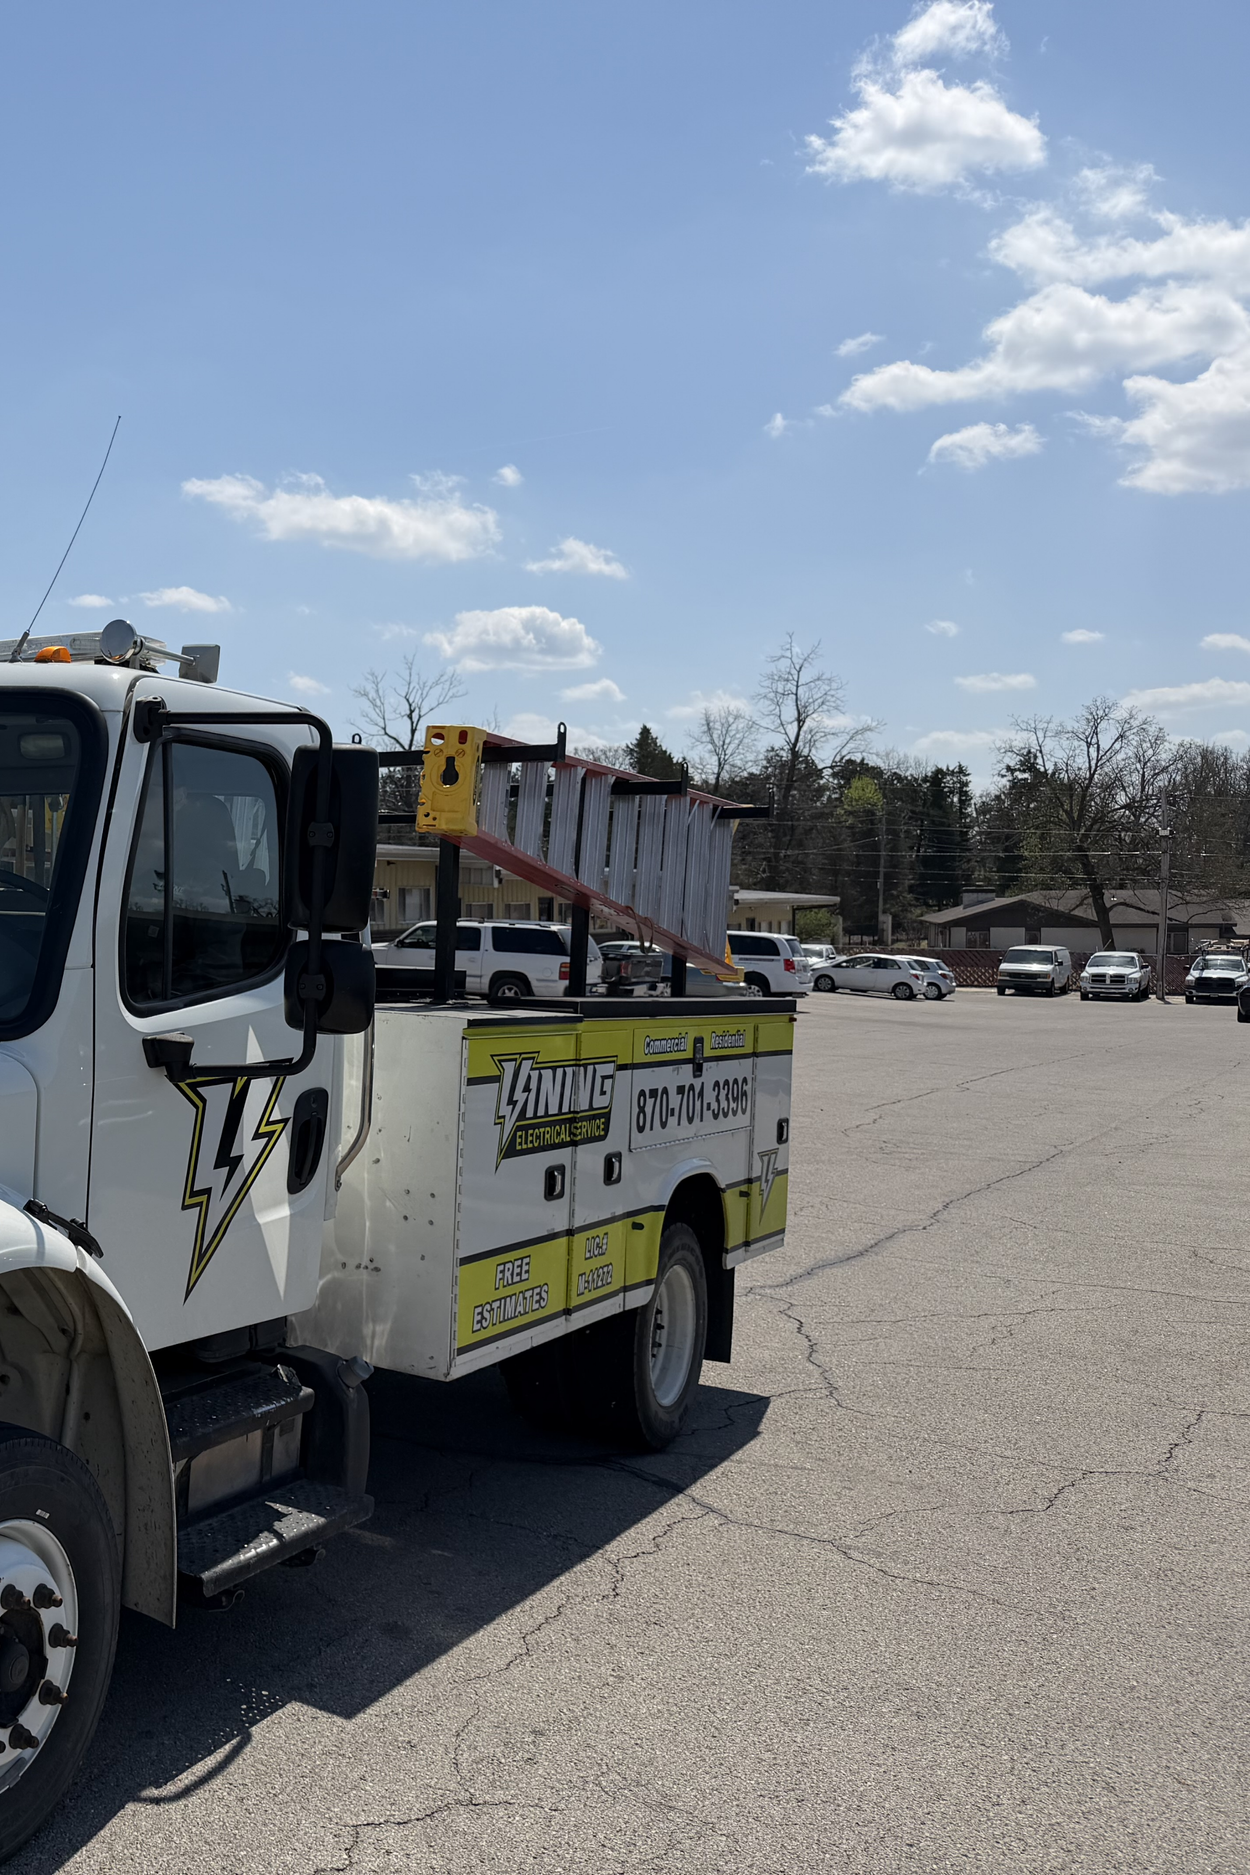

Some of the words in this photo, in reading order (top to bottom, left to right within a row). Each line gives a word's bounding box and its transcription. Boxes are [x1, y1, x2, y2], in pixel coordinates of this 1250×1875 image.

[643, 1032, 688, 1056] Commercial
[710, 1029, 746, 1050] Residential
[636, 1076, 748, 1134] 870-701-3396
[516, 1124, 571, 1150] ELECTRICAL
[570, 1118, 605, 1141] SERVICE
[494, 1255, 531, 1291] FREE
[472, 1283, 549, 1334] ESTIMATES
